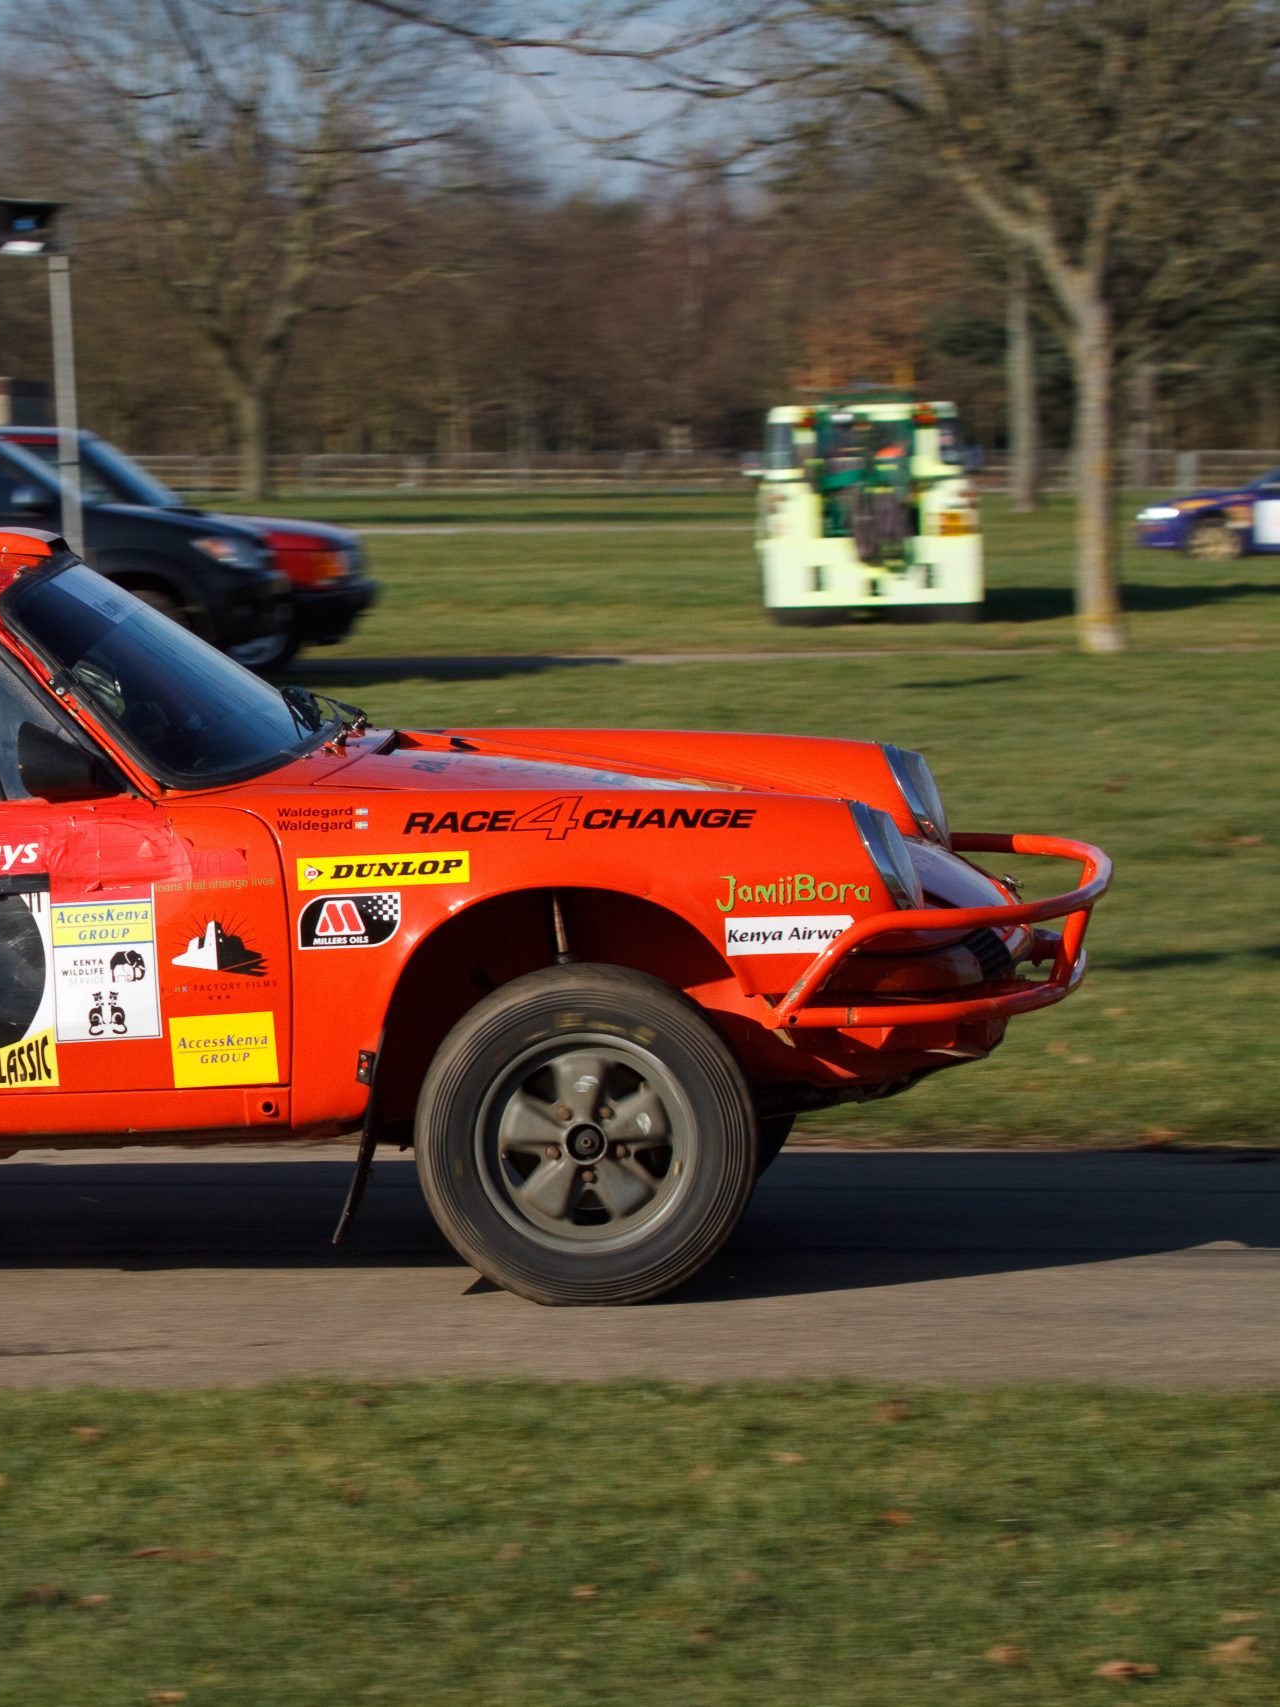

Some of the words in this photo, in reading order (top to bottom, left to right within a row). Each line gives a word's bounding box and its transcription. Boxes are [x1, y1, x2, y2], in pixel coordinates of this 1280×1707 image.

[277, 806, 353, 819] Waldegard
[277, 819, 353, 832] Waldegard
[330, 858, 463, 880] DUNLOP
[155, 879, 183, 892] loans
[186, 879, 207, 891] that
[209, 876, 249, 891] change
[252, 875, 276, 887] lives
[716, 873, 871, 912] JamiiBora
[56, 908, 149, 924] AccessKenya
[79, 928, 131, 941] GROUP
[313, 936, 348, 946] MILLERS
[349, 935, 370, 945] OILS
[728, 928, 783, 945] Kenya
[73, 958, 104, 967] KENYA
[62, 967, 104, 976] WILDLIFE
[68, 976, 105, 986] SERVICE
[194, 982, 242, 992] FACTORY
[246, 979, 279, 989] FILMS
[178, 1034, 269, 1050] AccessKenya
[200, 1052, 251, 1064] GROUP
